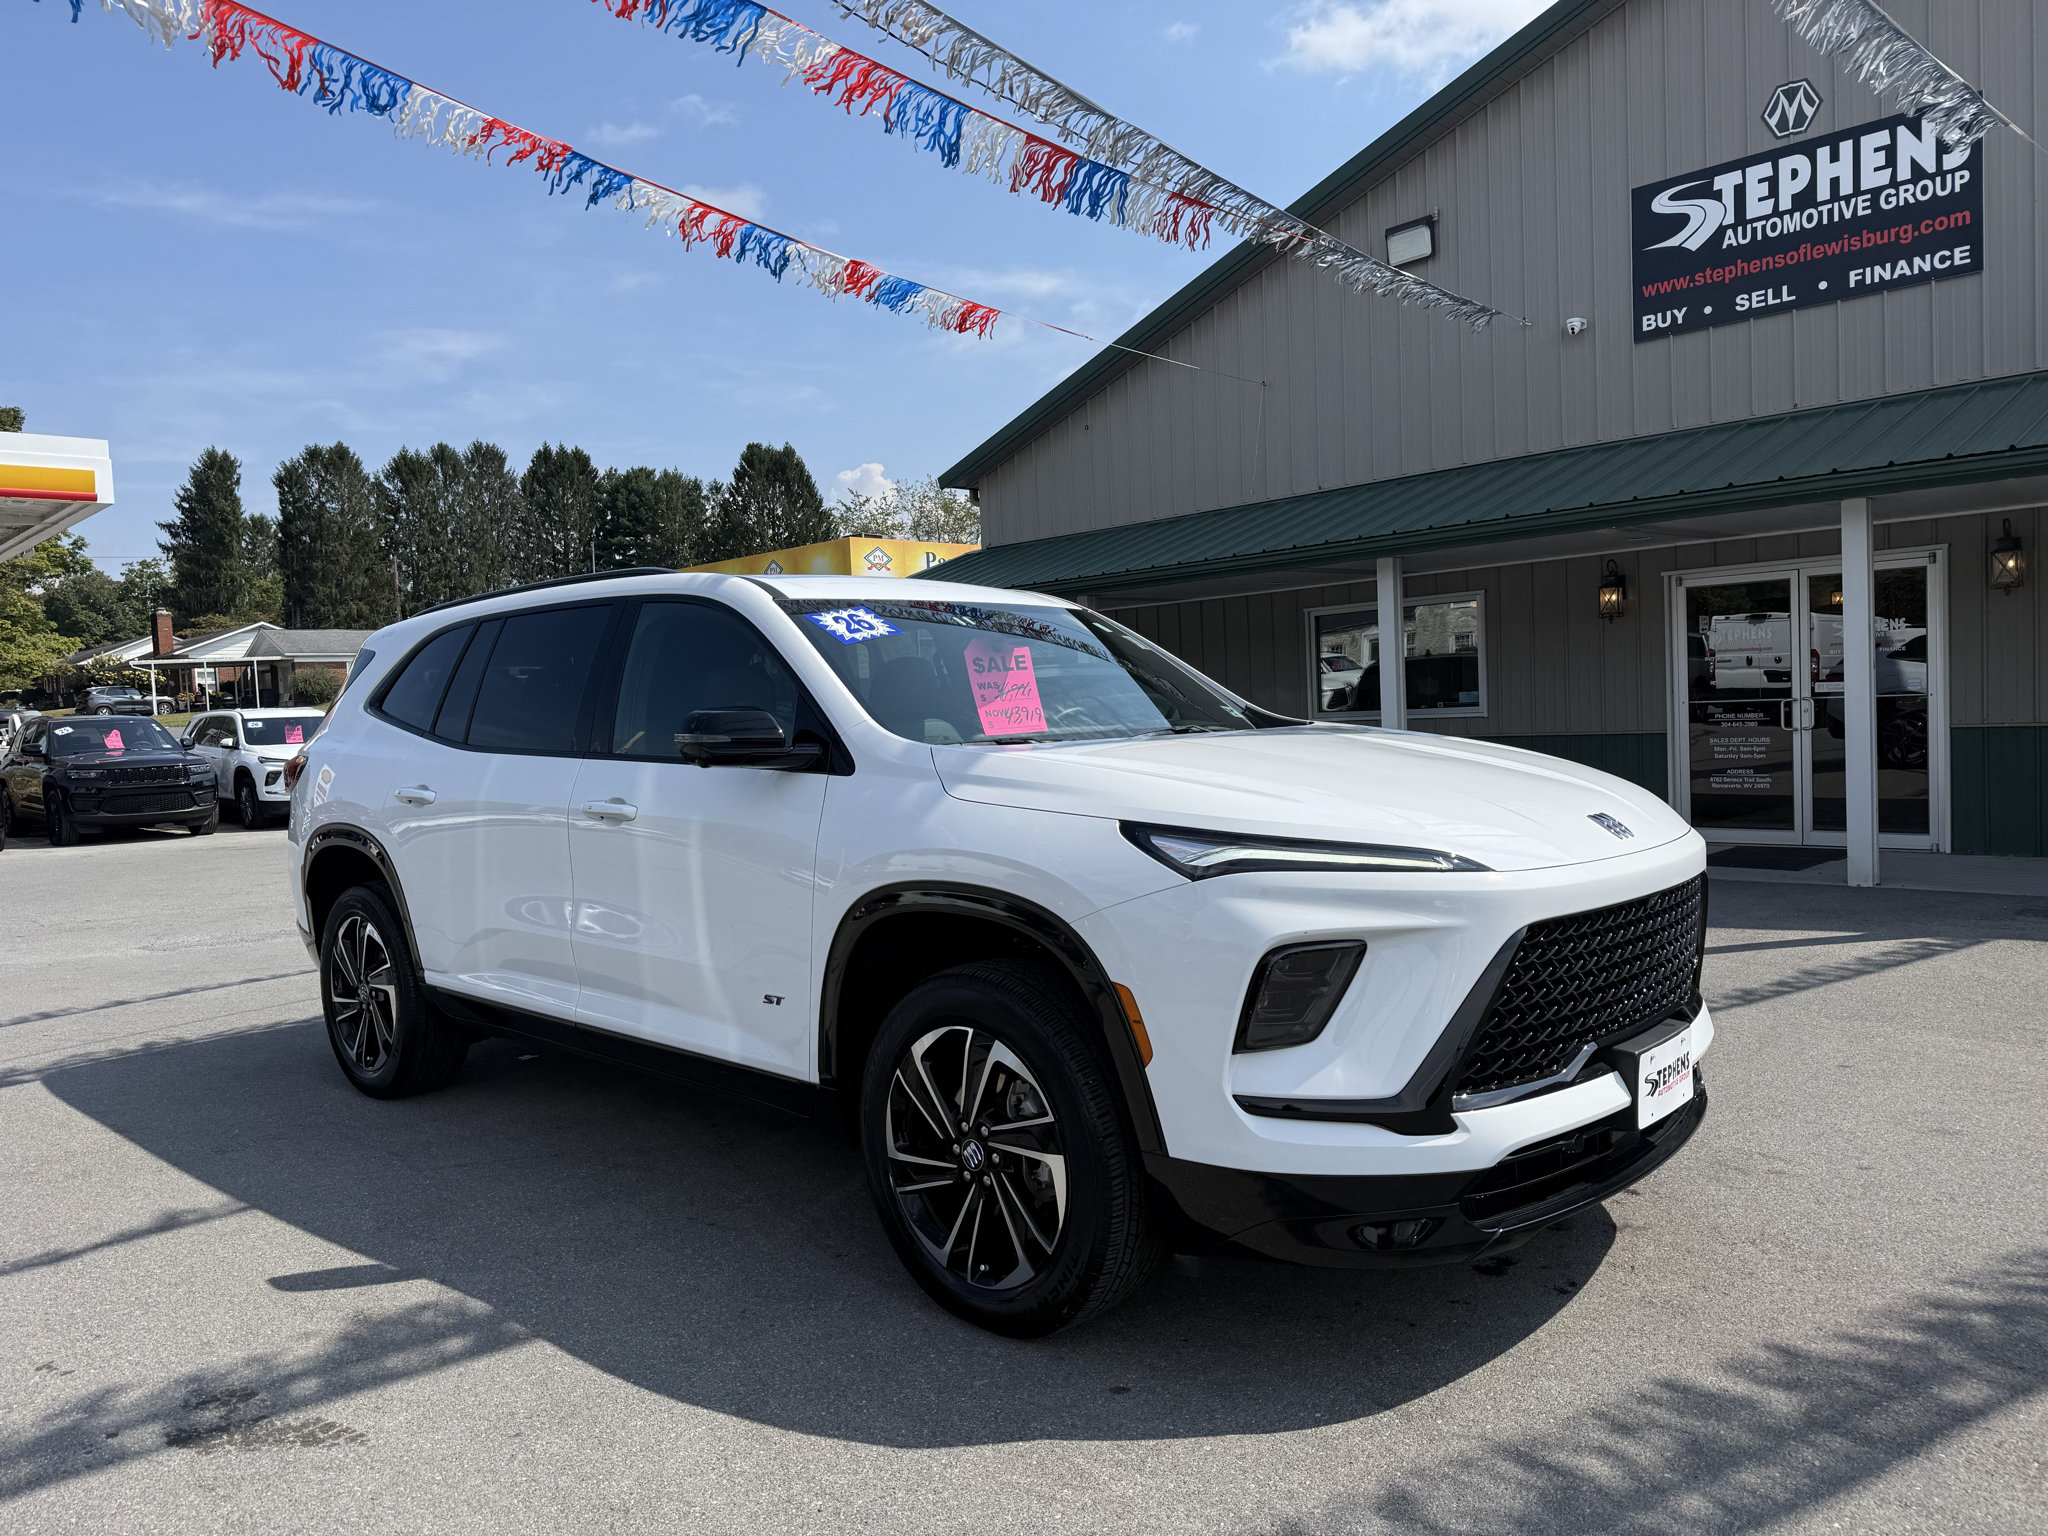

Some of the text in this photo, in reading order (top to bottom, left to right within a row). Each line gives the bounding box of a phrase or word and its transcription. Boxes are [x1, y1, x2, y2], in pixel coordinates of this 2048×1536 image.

[1722, 169, 1970, 249] AUTOMOTIVE GROUP
[1642, 210, 1971, 298] www.stephensoflewisburg.com
[1642, 245, 1971, 332] BUY SELL FINANCE
[831, 613, 876, 635] 26
[977, 681, 1000, 691] WAS
[984, 709, 1007, 718] NOW
[762, 994, 785, 1006] ST
[1644, 1050, 1690, 1097] STEPHENS
